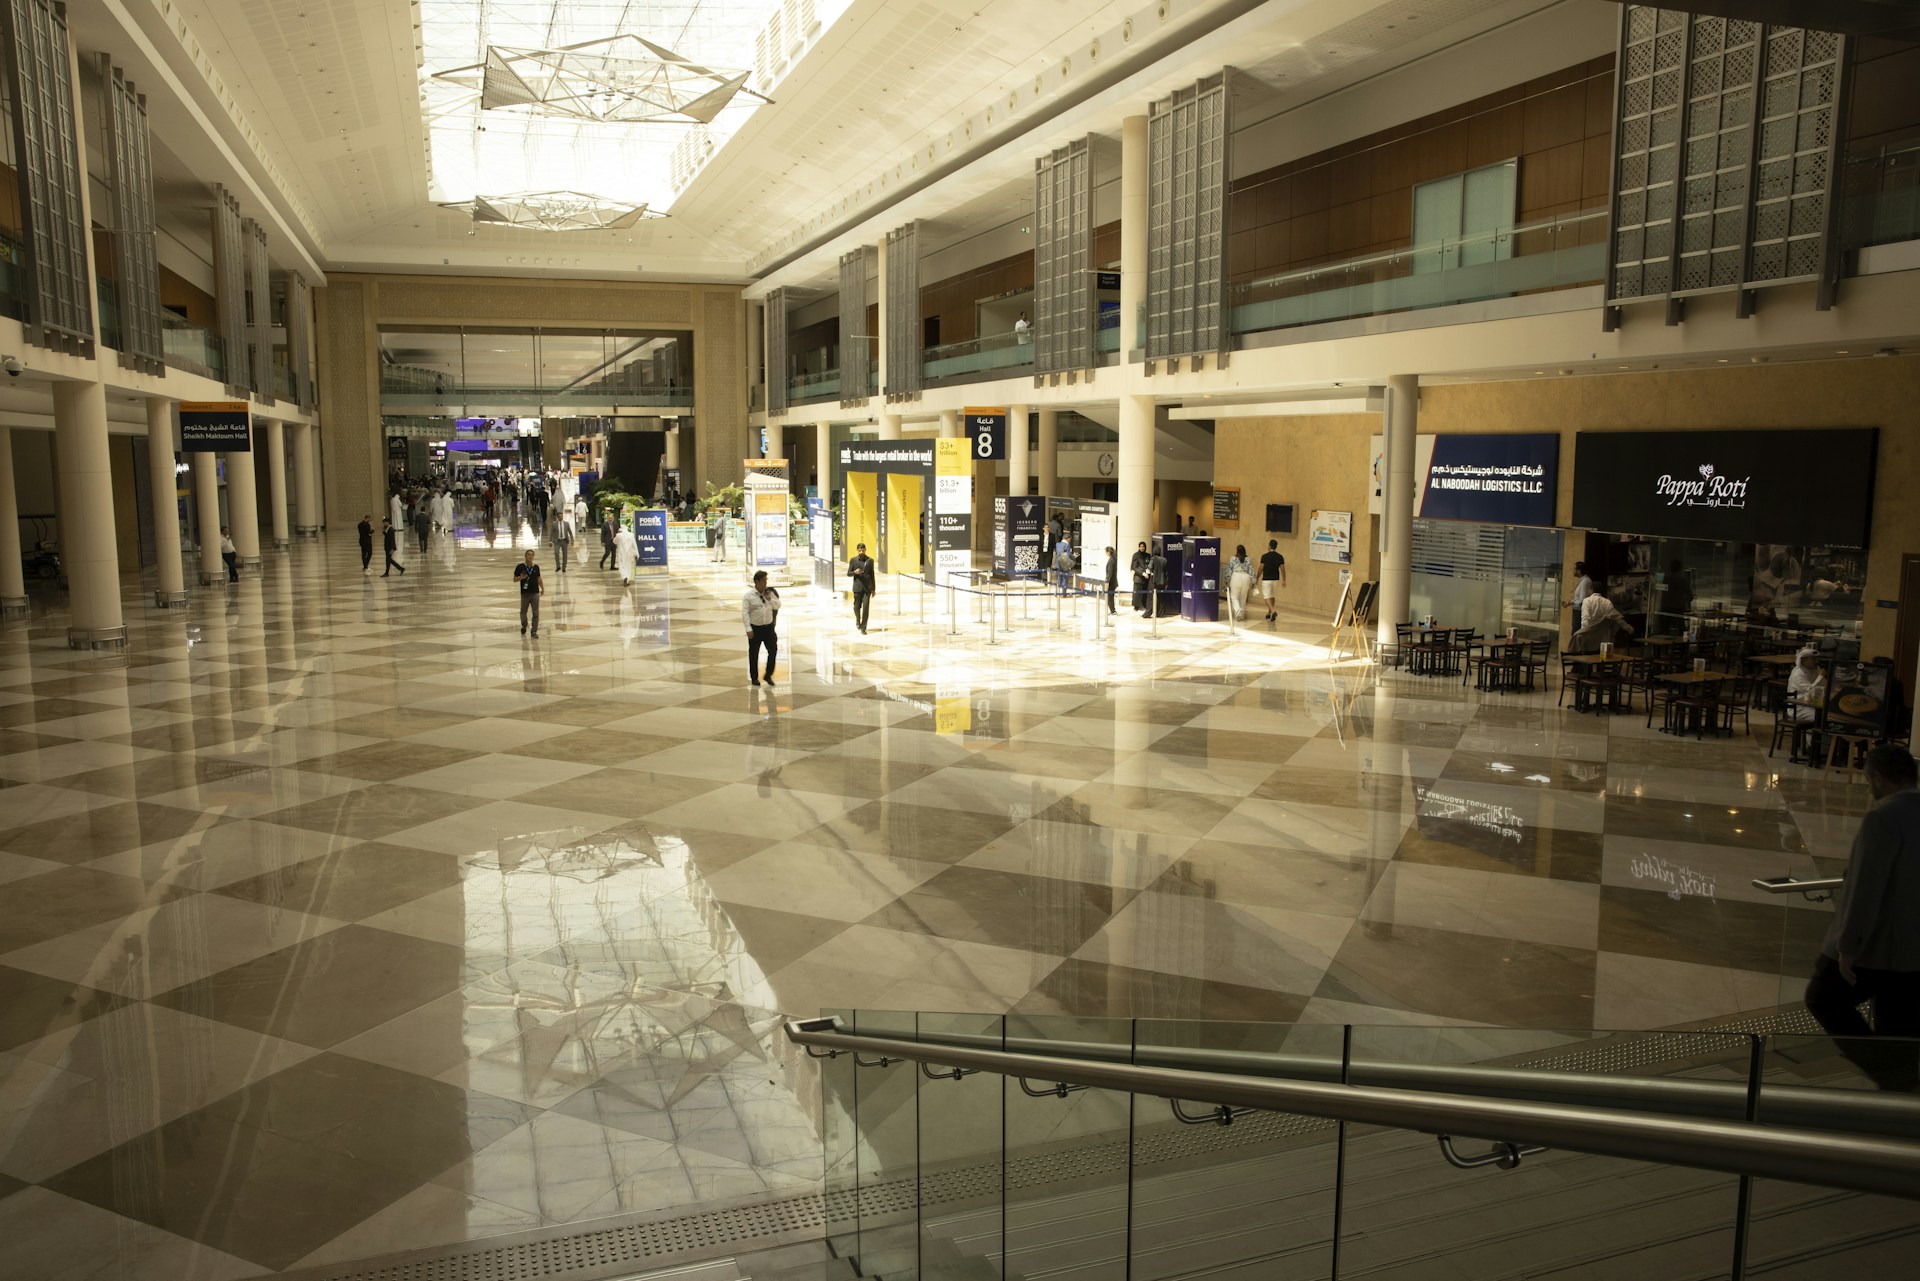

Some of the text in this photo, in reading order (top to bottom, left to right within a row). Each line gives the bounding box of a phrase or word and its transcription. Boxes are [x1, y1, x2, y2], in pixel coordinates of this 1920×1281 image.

[184, 424, 208, 432] مكتوم
[210, 423, 229, 432] الشيخ
[939, 442, 954, 450] $3+
[977, 432, 993, 458] 8
[875, 450, 887, 464] largest
[887, 450, 897, 461] retail
[897, 450, 909, 461] broker
[920, 450, 932, 462] world
[1521, 464, 1543, 477] شركة
[1431, 477, 1543, 494] AL NABOODAH LOGISTICS L.L.C
[1656, 474, 1751, 507] Pappa Roti
[939, 516, 958, 525] 110+
[939, 554, 958, 562] 550+
